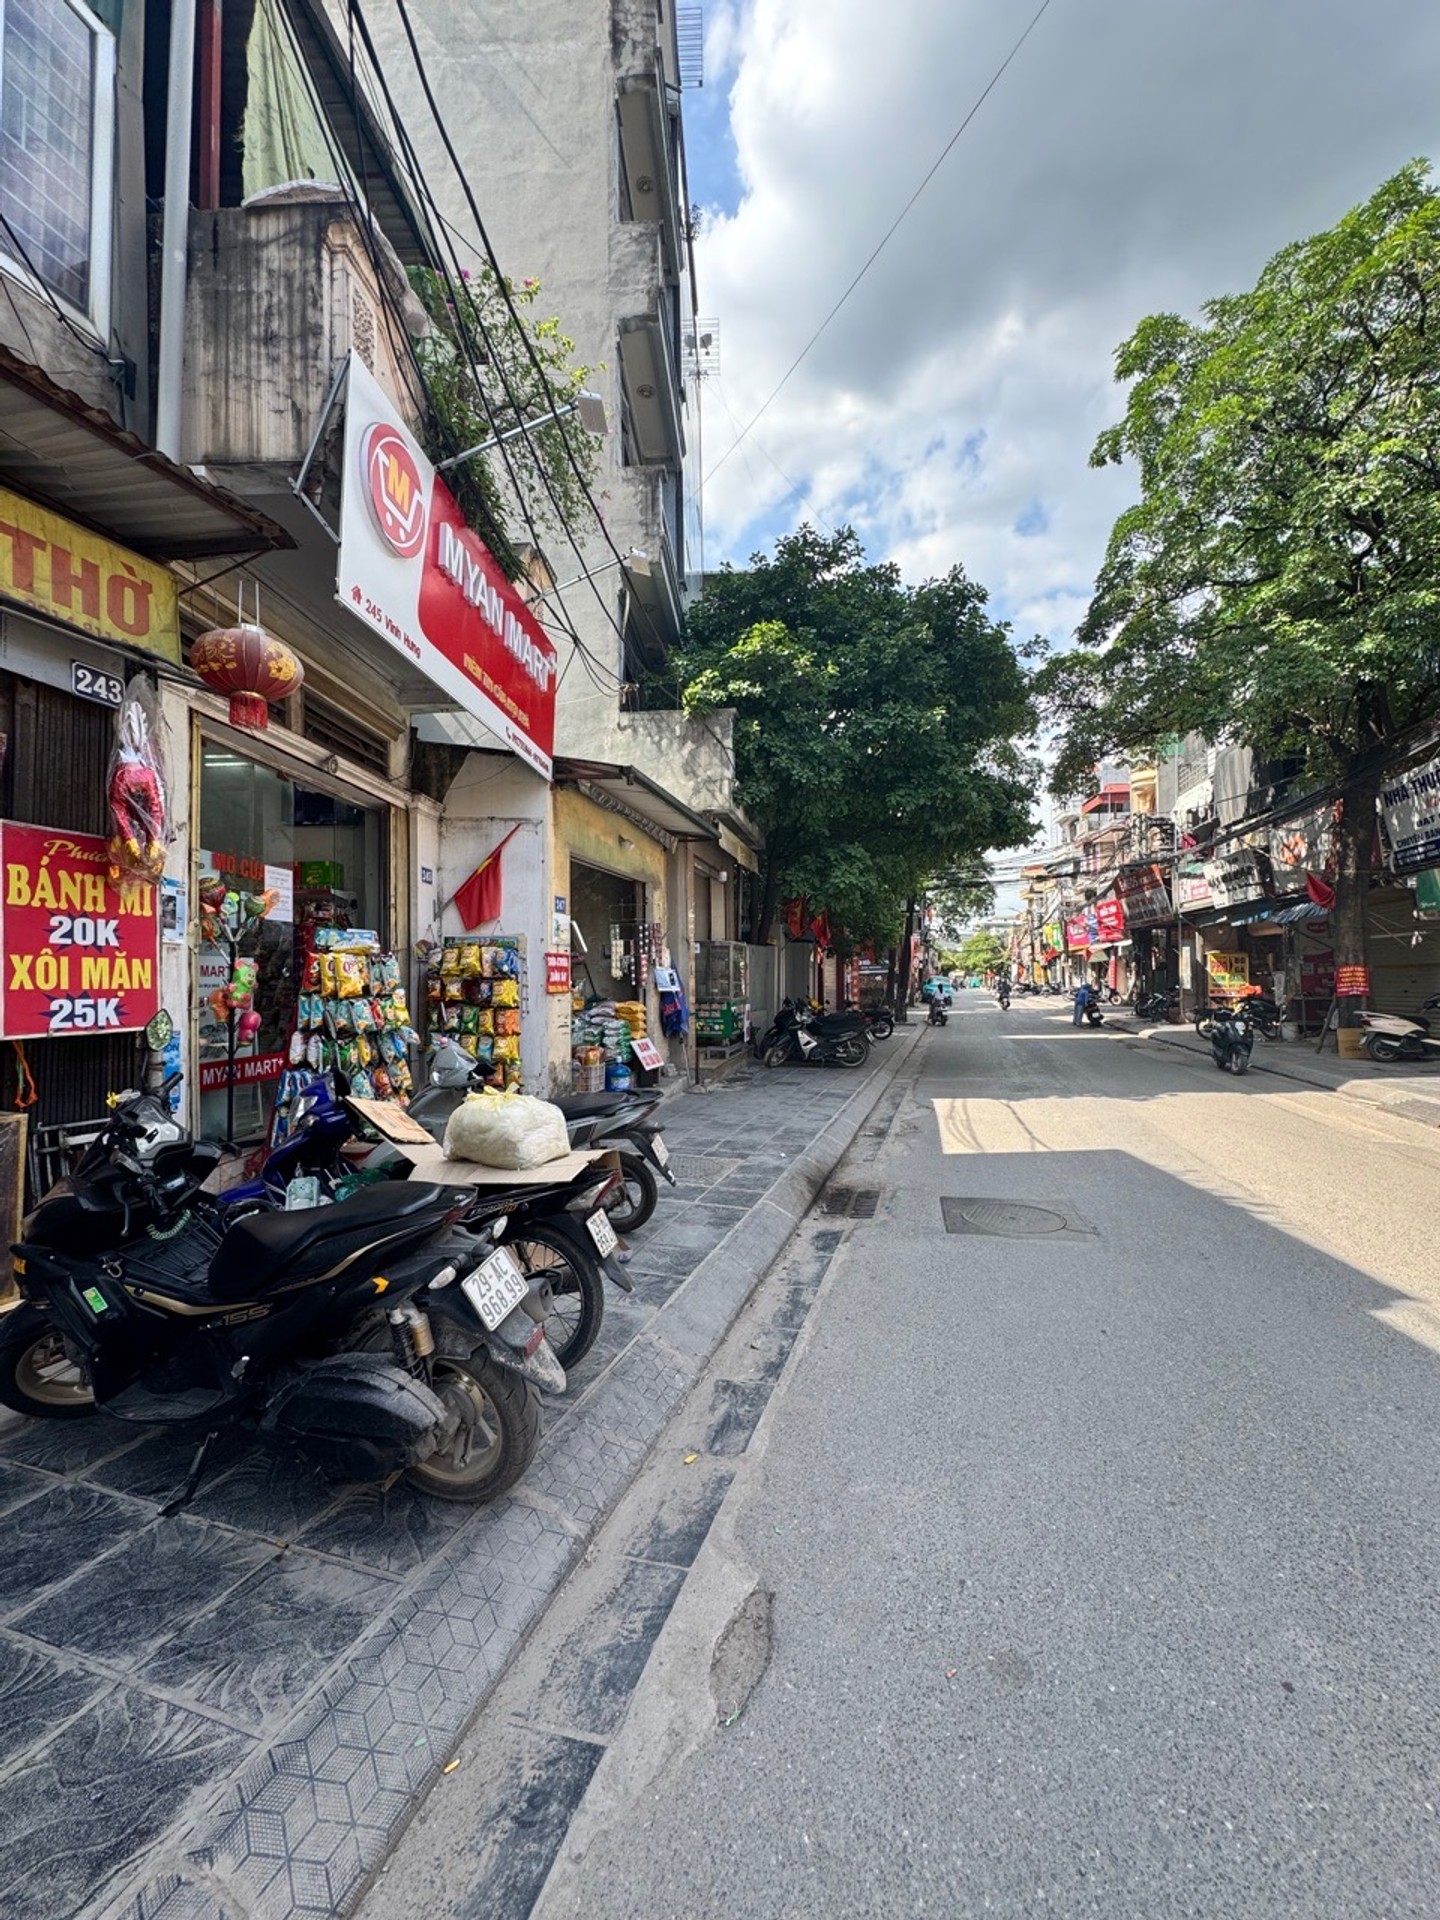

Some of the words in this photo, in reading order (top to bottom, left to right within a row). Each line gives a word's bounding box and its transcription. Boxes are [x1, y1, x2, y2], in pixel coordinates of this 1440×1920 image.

[0, 519, 154, 637] THỜ
[438, 522, 504, 636] MYAN
[365, 598, 382, 623] 245
[75, 668, 123, 703] 243
[6, 856, 106, 913] BÁNH
[49, 915, 120, 947] 20K
[9, 948, 70, 990] XÔI
[82, 951, 152, 997] MẶN
[49, 997, 121, 1029] 25K
[472, 1256, 508, 1299] 29-AC
[482, 1273, 523, 1323] 968.99
